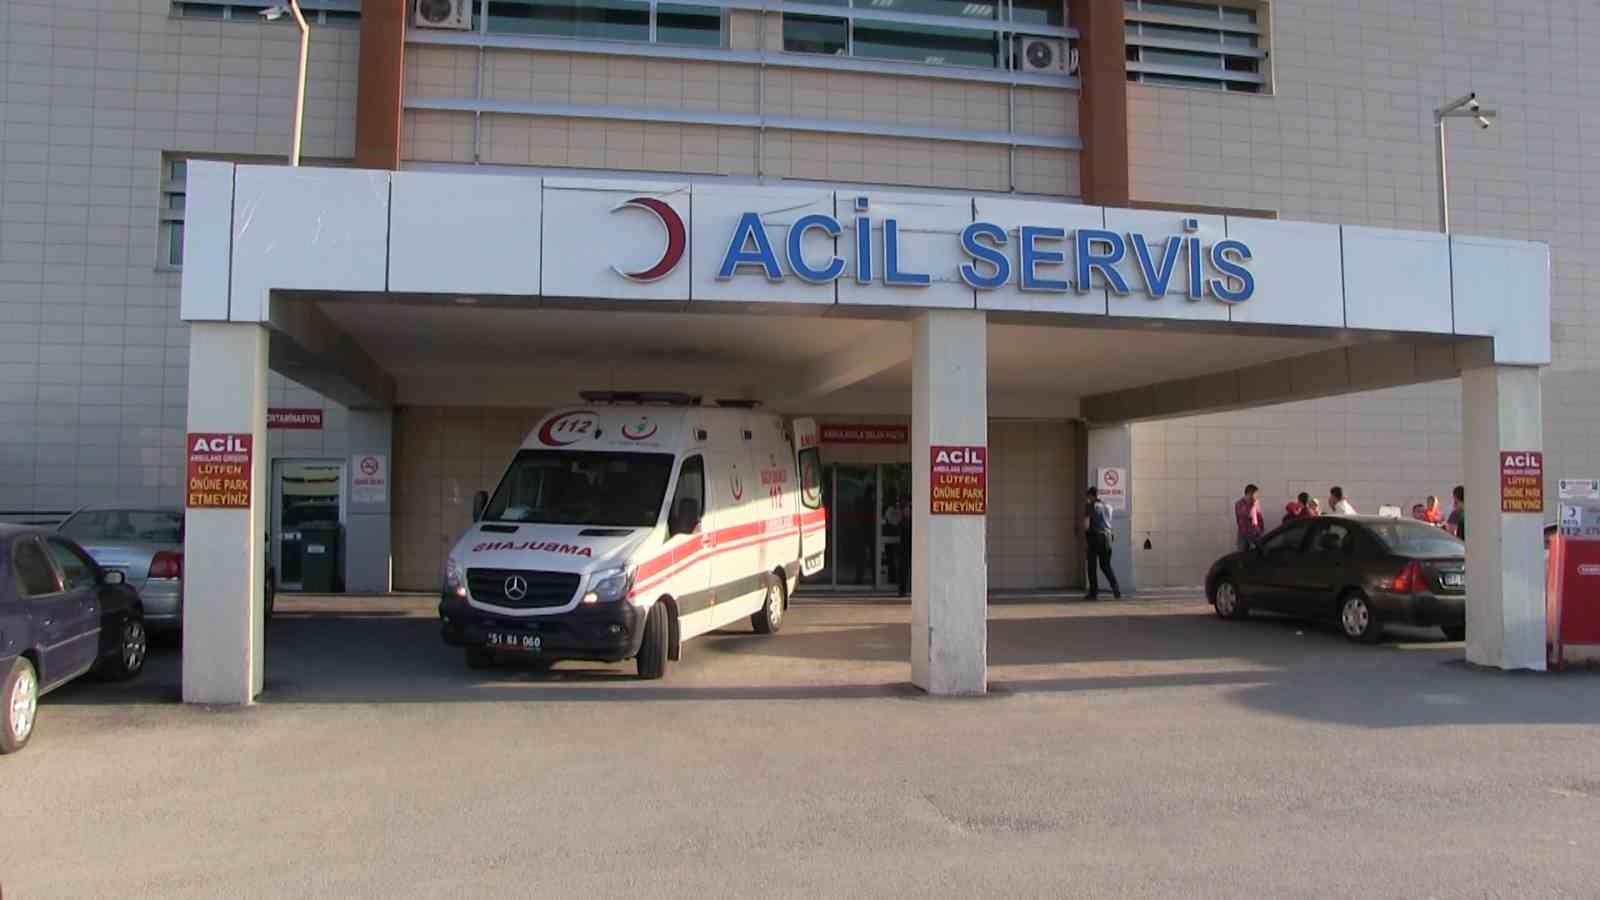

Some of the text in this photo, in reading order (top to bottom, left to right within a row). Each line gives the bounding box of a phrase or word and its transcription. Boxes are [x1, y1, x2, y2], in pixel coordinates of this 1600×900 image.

[715, 195, 1257, 303] ACİL SERVİS
[557, 420, 593, 433] 112
[193, 435, 248, 452] ACİL
[935, 447, 983, 464] ACİL
[1504, 452, 1540, 467] ACİL
[198, 462, 242, 474] LÜTFEN
[190, 477, 248, 491] ÖNÜNE PARK
[940, 473, 978, 485] LÜTFEN
[189, 492, 248, 505] ETMEYİNİZ
[933, 486, 984, 499] ÖNÜNE PARK
[932, 499, 985, 512] ETMEYİNİZ
